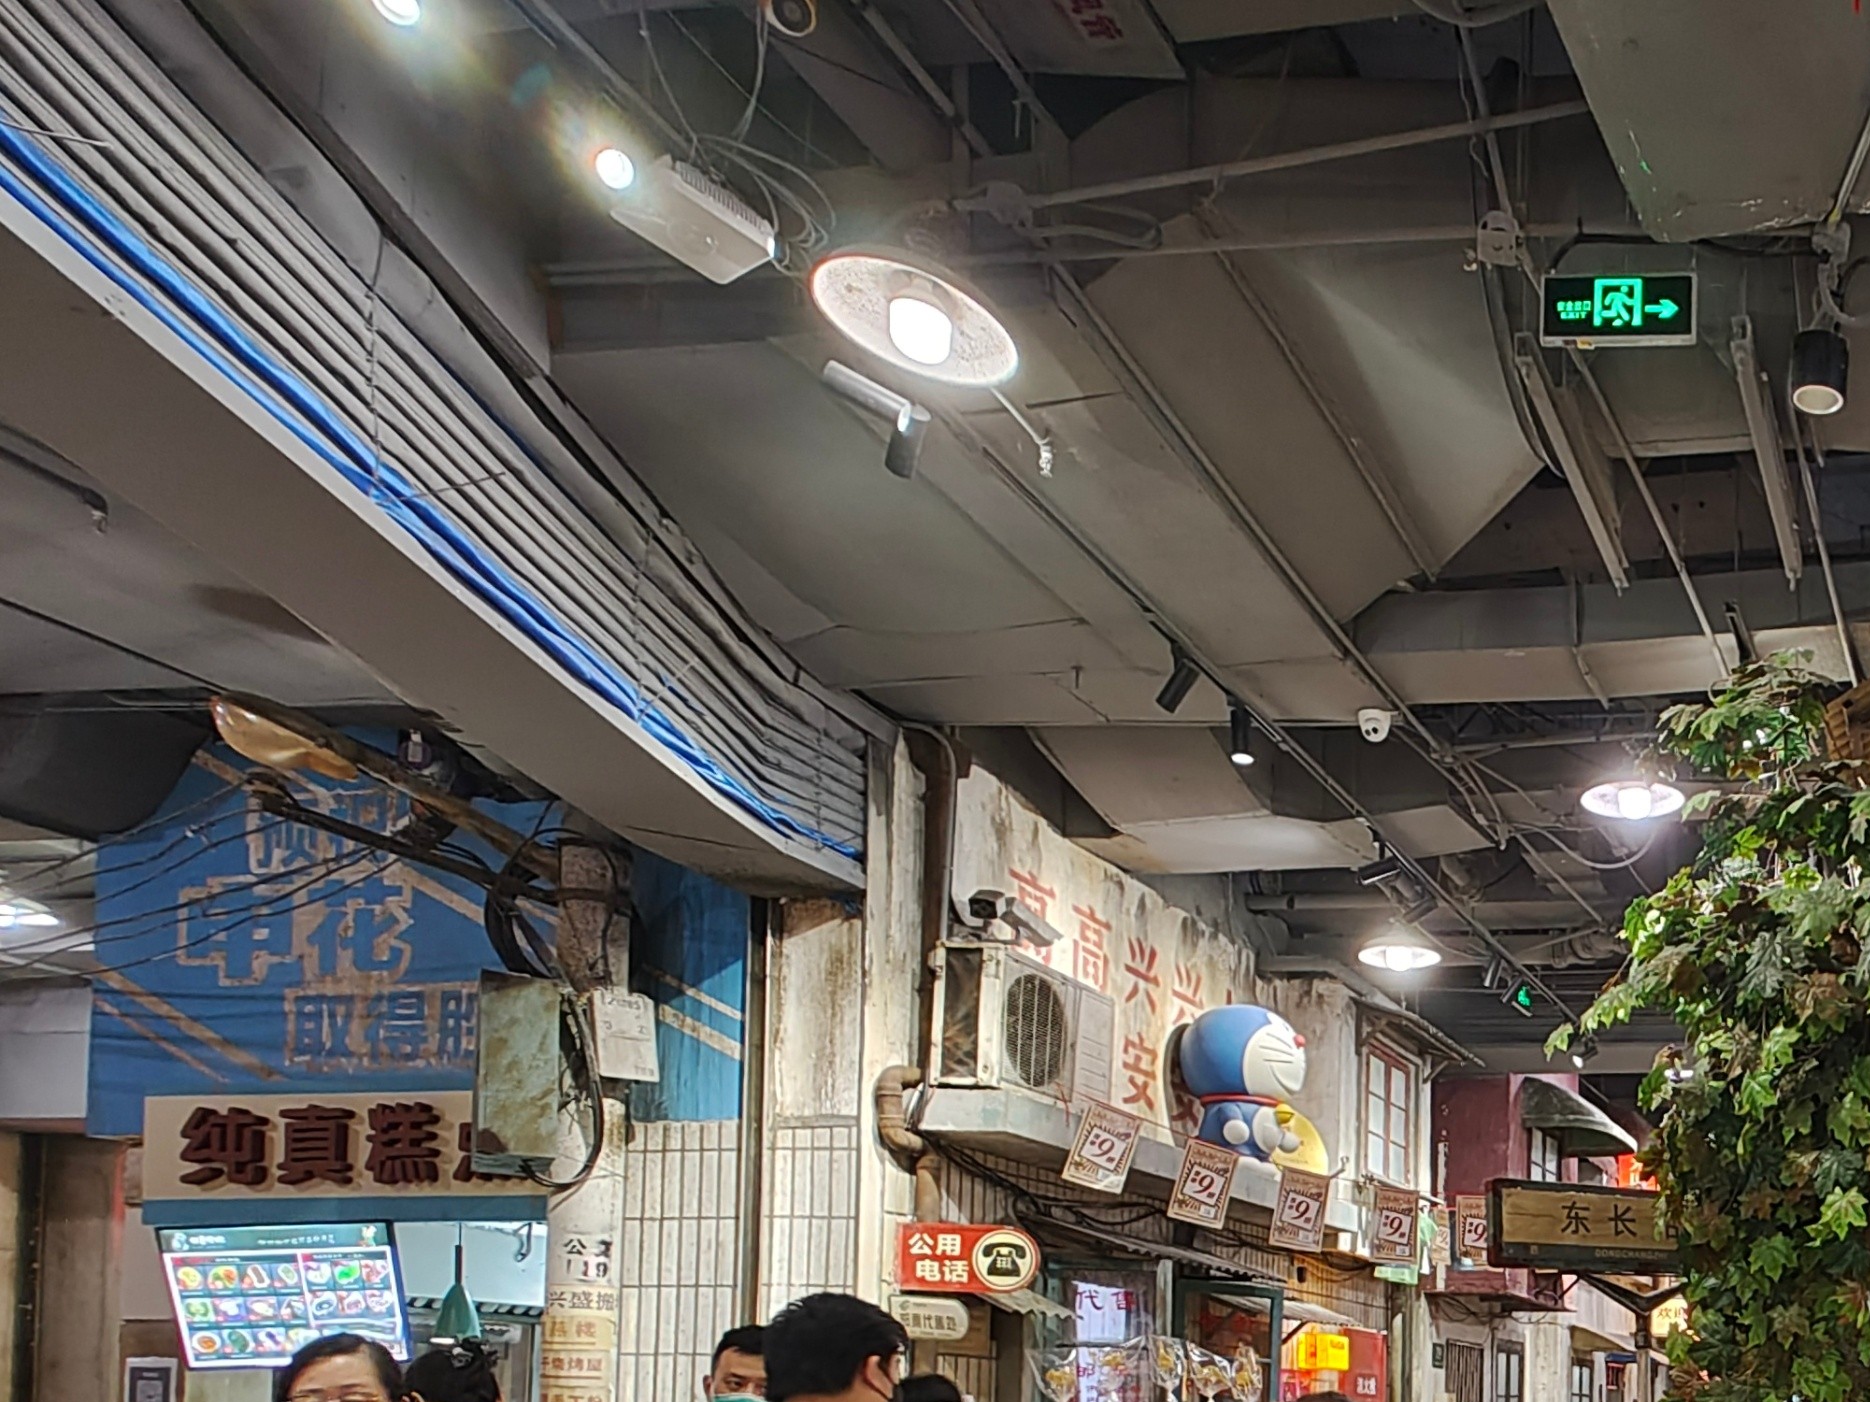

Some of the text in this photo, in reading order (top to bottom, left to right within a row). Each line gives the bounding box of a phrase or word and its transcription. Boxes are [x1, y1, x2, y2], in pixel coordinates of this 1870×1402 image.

[178, 872, 412, 985] 申花
[1009, 866, 1232, 1024] 高高兴兴
[908, 1233, 961, 1256] 公用
[916, 1259, 969, 1283] 电话
